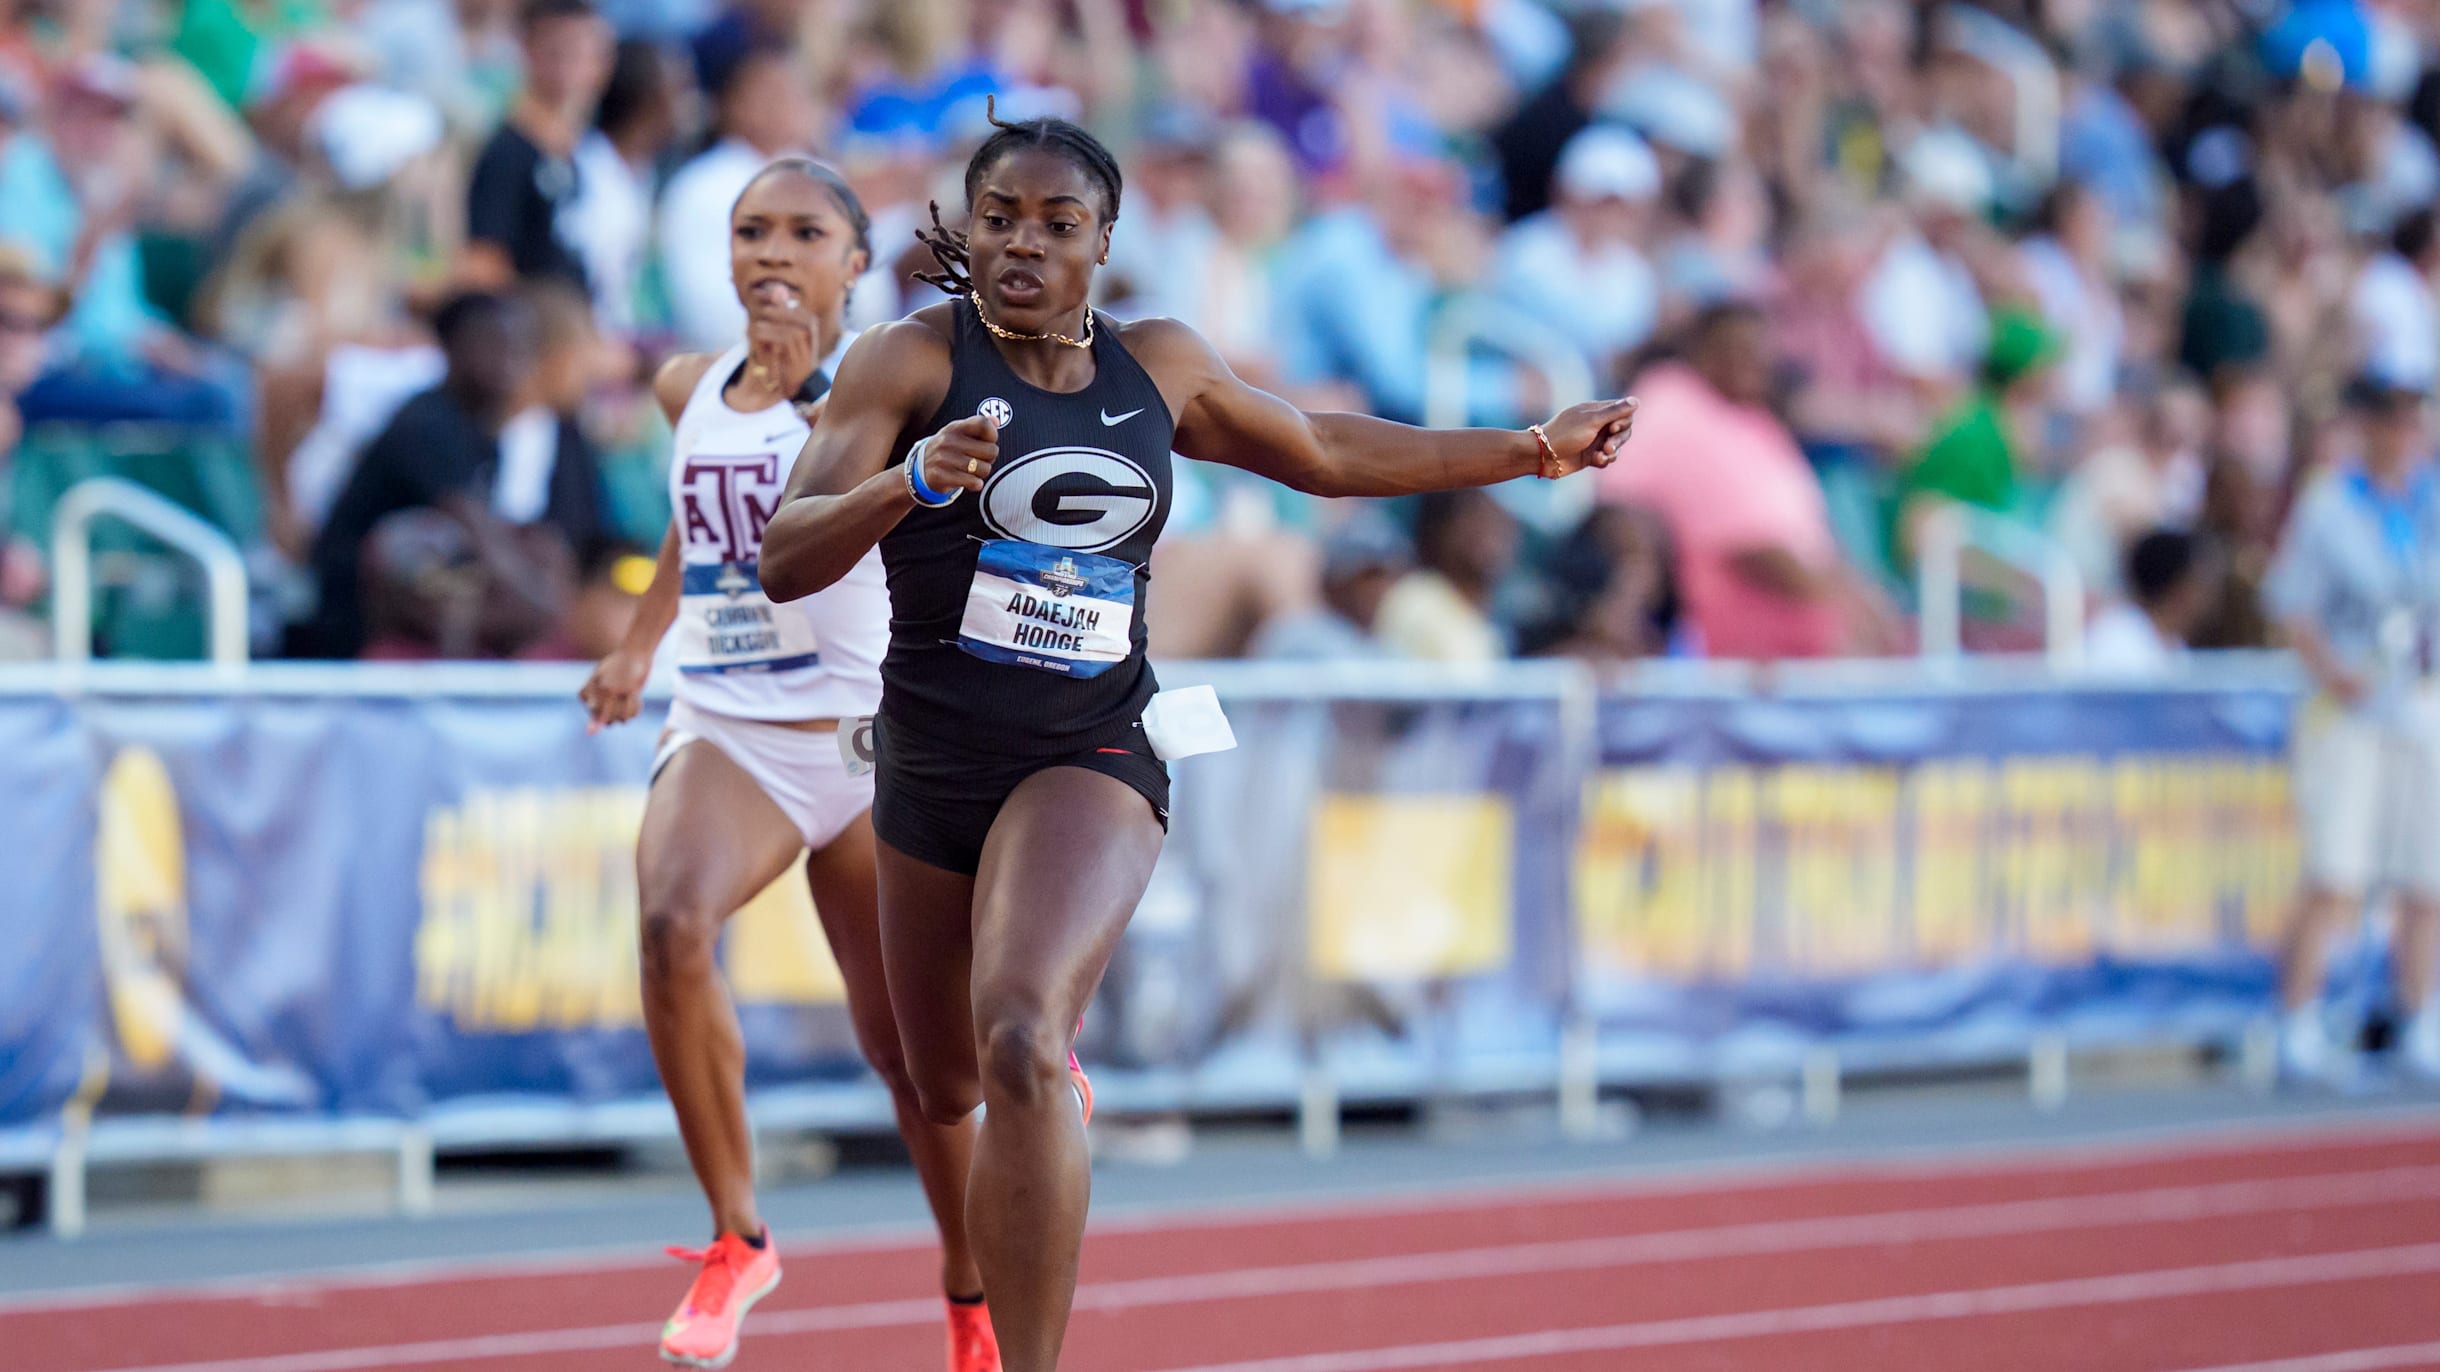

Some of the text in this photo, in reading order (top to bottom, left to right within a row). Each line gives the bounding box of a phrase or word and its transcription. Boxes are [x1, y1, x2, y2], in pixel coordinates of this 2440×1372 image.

[980, 400, 1009, 425] SEC
[986, 450, 1154, 549] G
[1006, 593, 1100, 631] ADAEJAH
[1013, 623, 1084, 651] HODGE
[1016, 655, 1071, 672] EUGENE, OREGON
